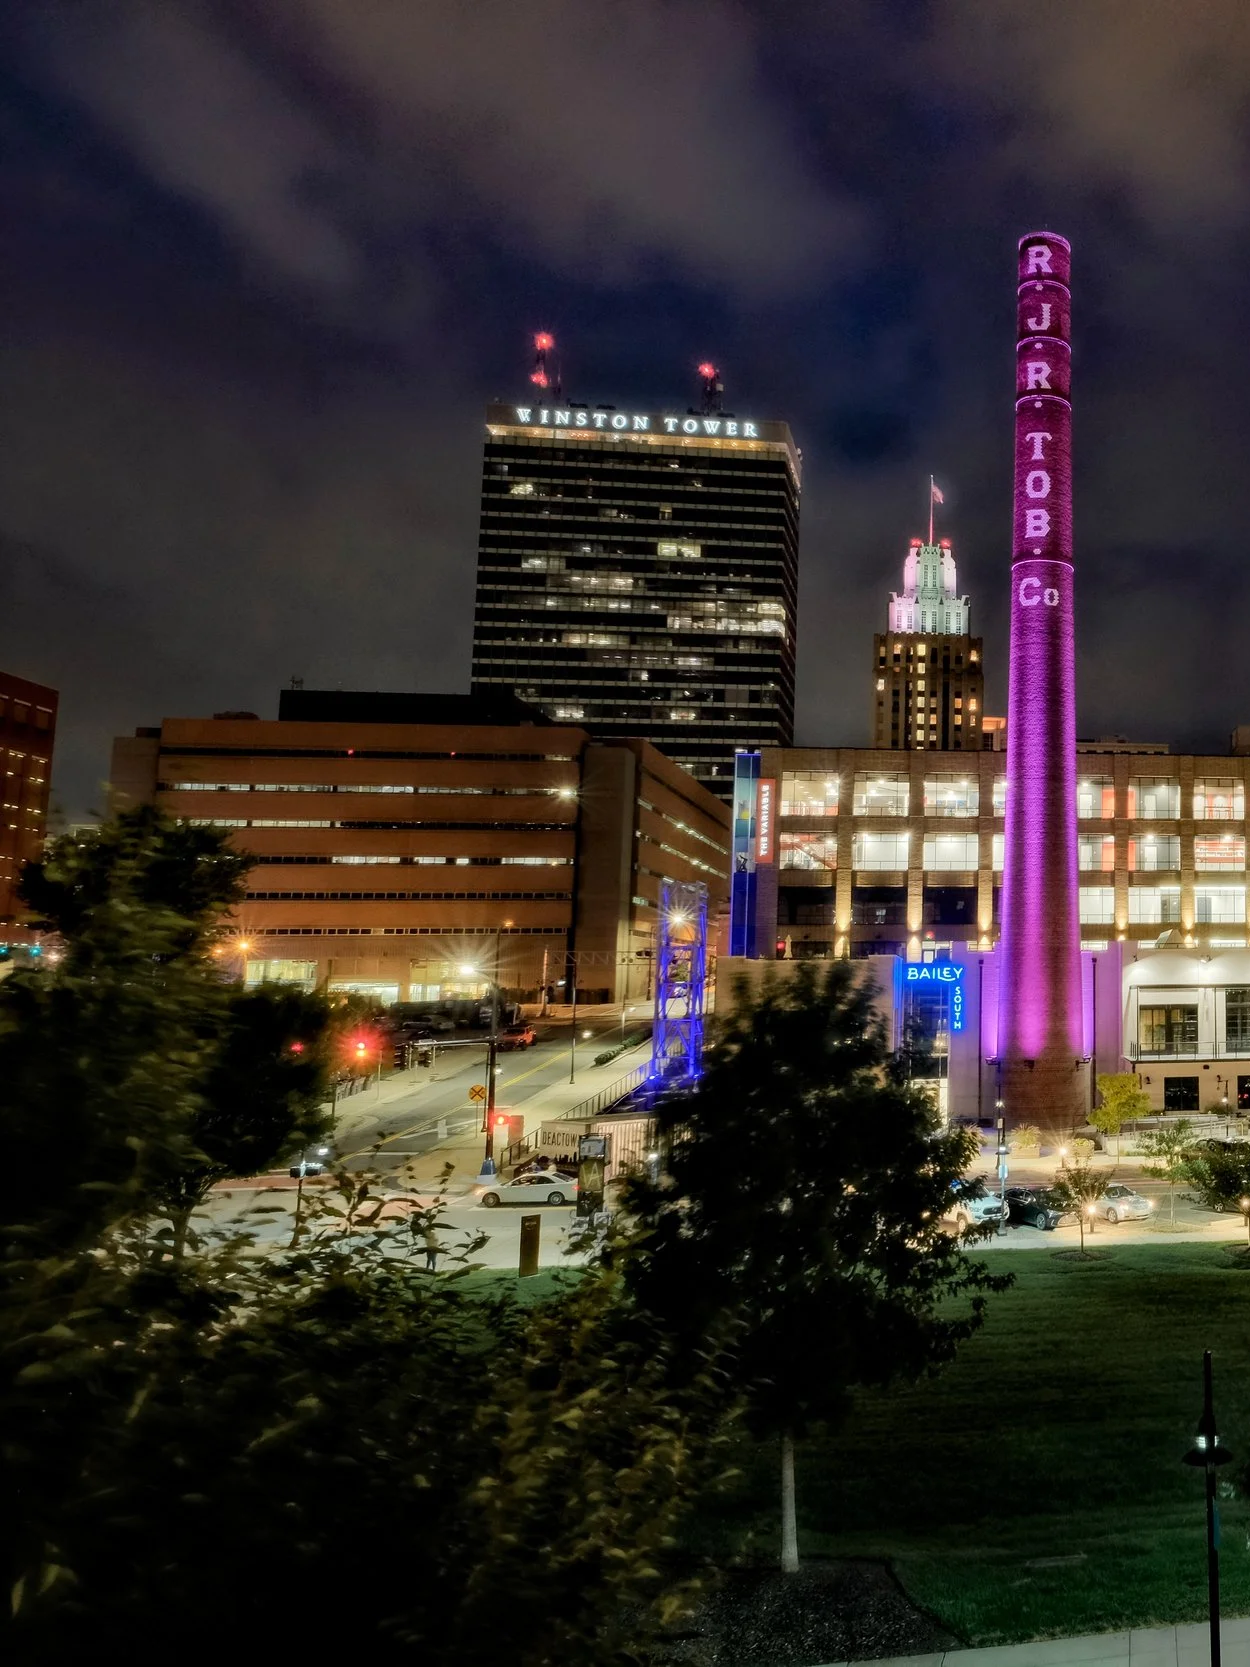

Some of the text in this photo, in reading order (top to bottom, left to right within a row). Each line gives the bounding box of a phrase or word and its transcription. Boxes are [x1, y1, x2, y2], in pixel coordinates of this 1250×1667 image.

[516, 408, 759, 438] WINSTON TOWER
[760, 784, 770, 857] THE VARIABLE
[907, 967, 963, 982] BAILEY
[953, 986, 962, 1029] SOUTH
[542, 1131, 579, 1148] DEACTOW
